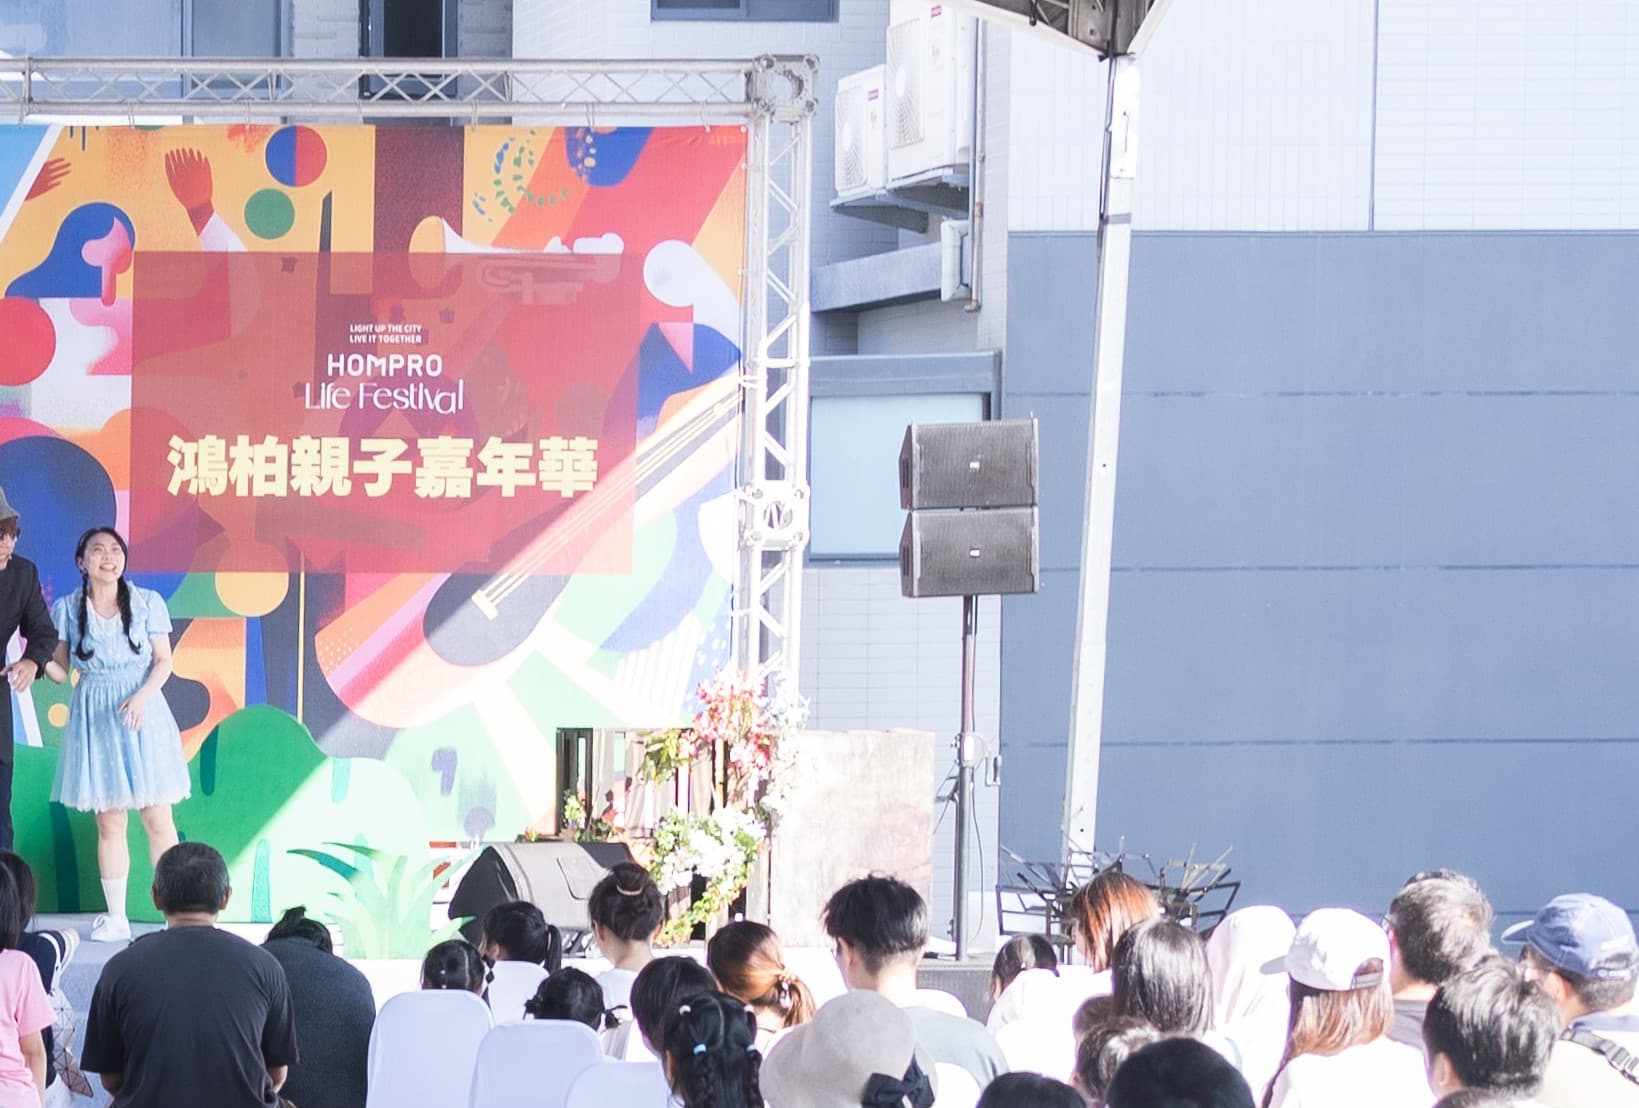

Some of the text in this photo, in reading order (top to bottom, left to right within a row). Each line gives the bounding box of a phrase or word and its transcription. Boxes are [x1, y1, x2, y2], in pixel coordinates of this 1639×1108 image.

[349, 323, 422, 333] LIGHT UP THE CITY
[349, 334, 422, 344] LIVE IT TOGETHER
[327, 353, 443, 377] HOMPRO
[305, 378, 464, 414] Life Festival
[166, 433, 599, 499] 鴻柏親子嘉年華
